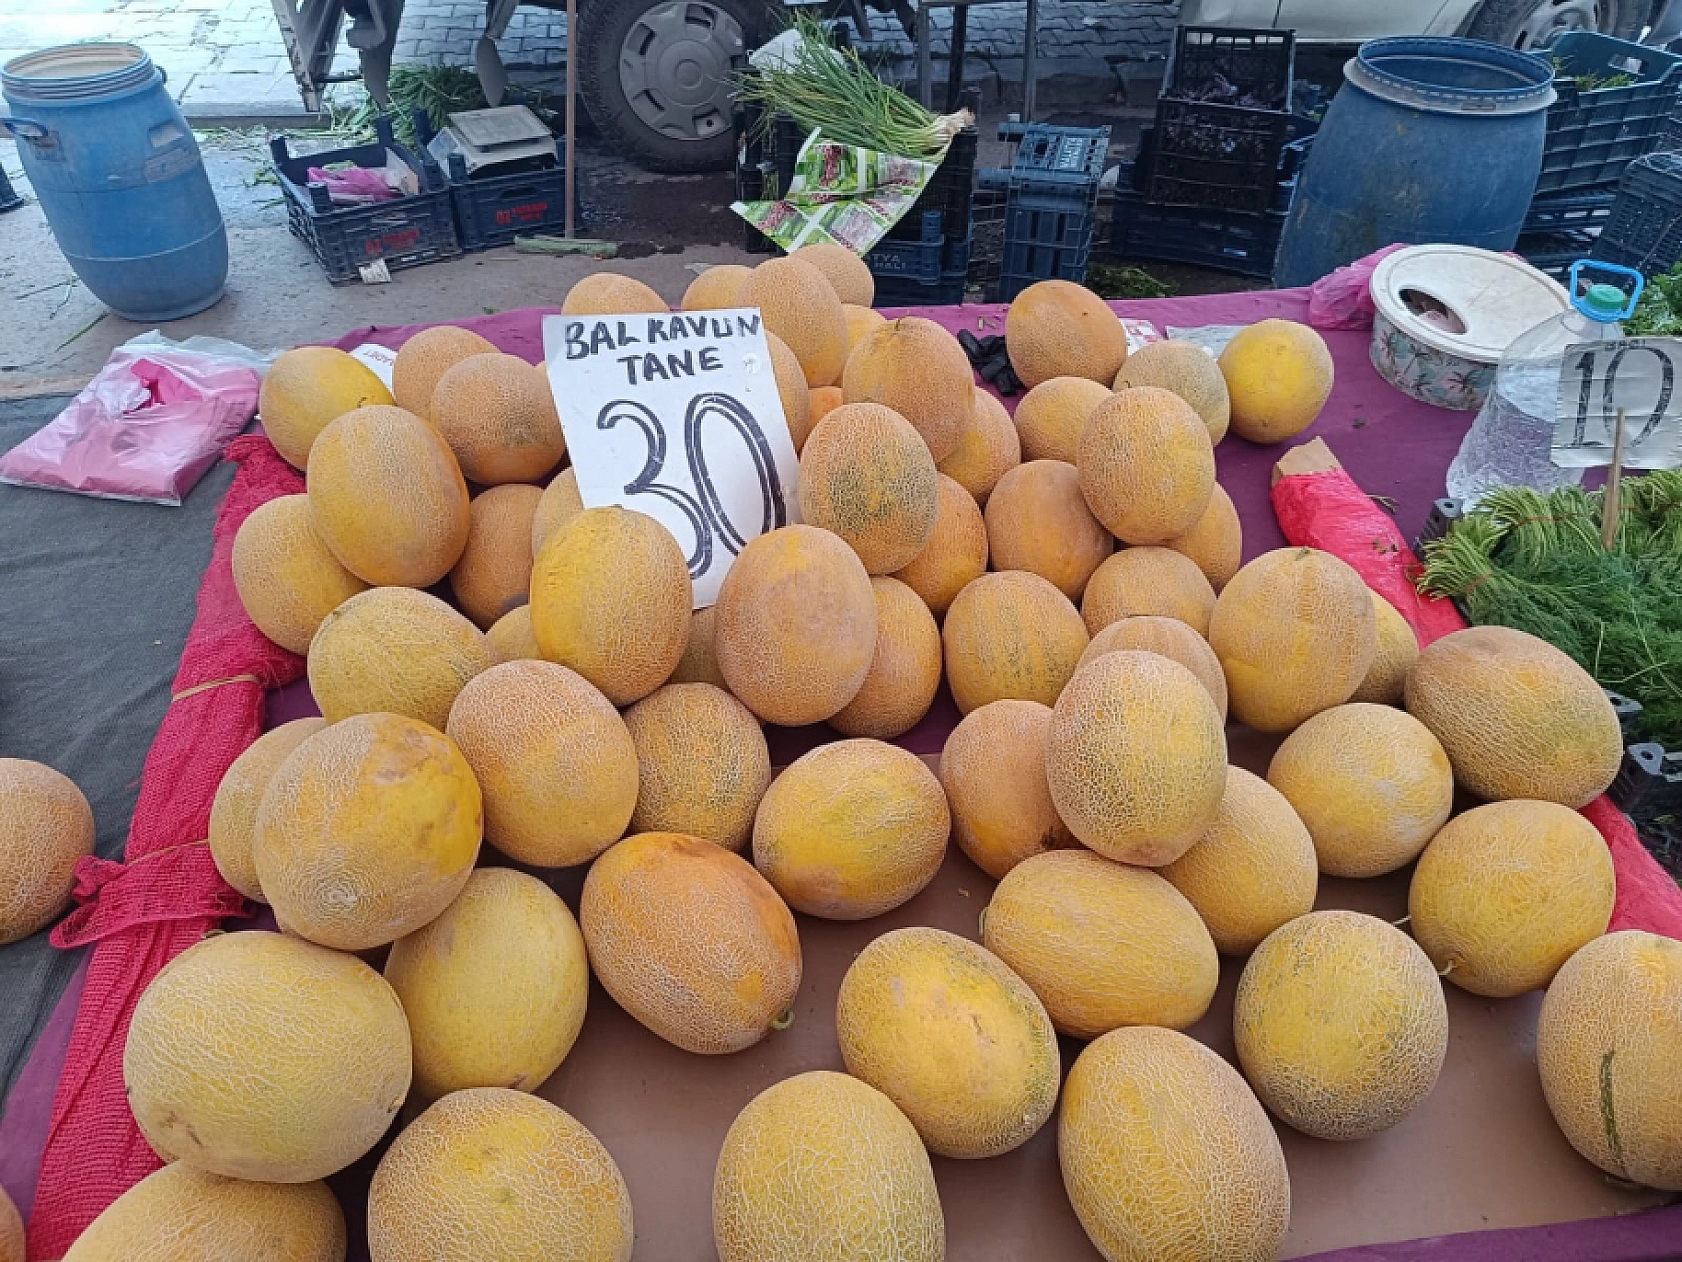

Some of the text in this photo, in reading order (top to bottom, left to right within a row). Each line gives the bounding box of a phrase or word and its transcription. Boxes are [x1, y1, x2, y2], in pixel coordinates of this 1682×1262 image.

[565, 314, 760, 359] BAL KAVUN
[616, 347, 724, 385] TANE
[1568, 347, 1674, 447] 10
[596, 392, 787, 580] 30
